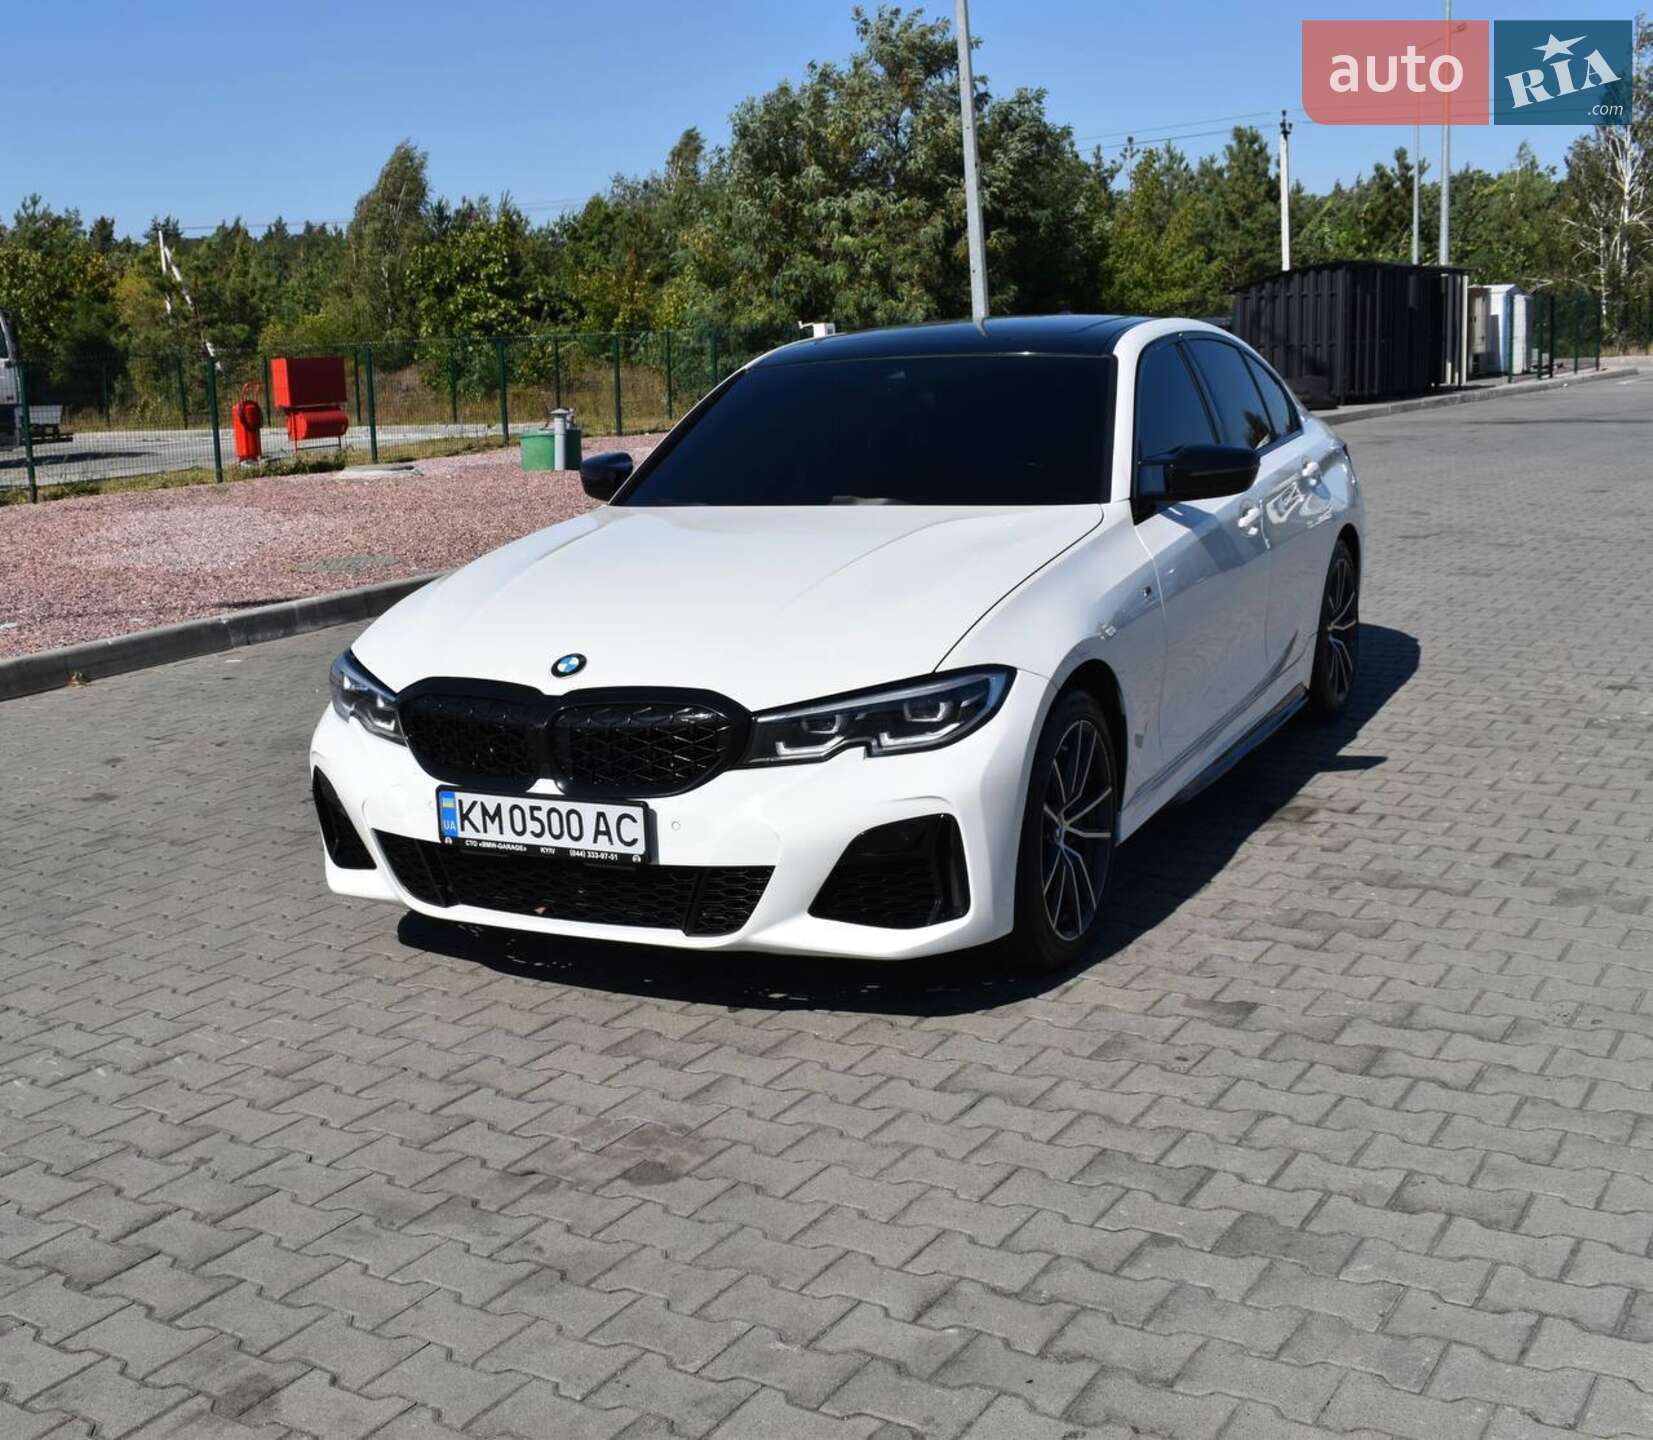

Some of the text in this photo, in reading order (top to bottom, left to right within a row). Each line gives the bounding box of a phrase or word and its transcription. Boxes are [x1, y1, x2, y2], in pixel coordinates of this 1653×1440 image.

[443, 820, 456, 831] UA
[458, 799, 639, 847] KM 0500 AC
